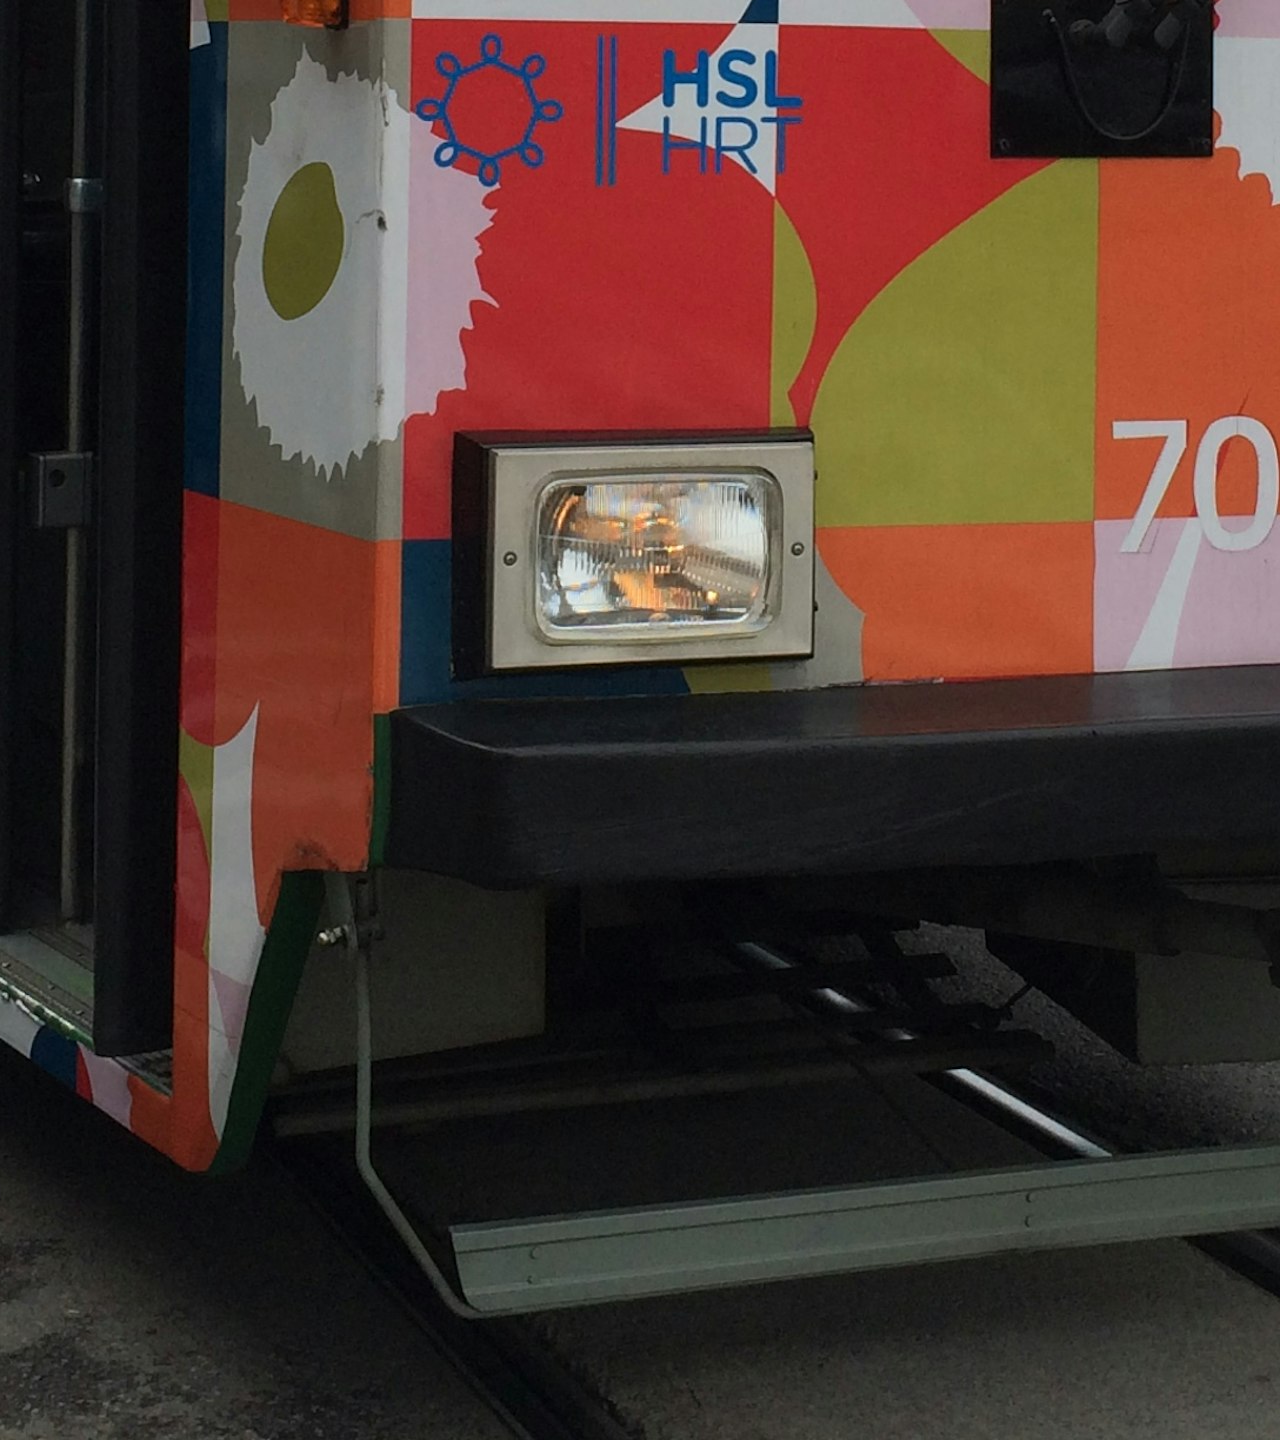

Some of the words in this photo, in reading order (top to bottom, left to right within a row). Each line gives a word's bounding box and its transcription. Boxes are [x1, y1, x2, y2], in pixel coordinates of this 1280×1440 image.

[662, 48, 803, 108] HSL
[661, 116, 803, 174] HRT
[1112, 416, 1280, 552] 70
